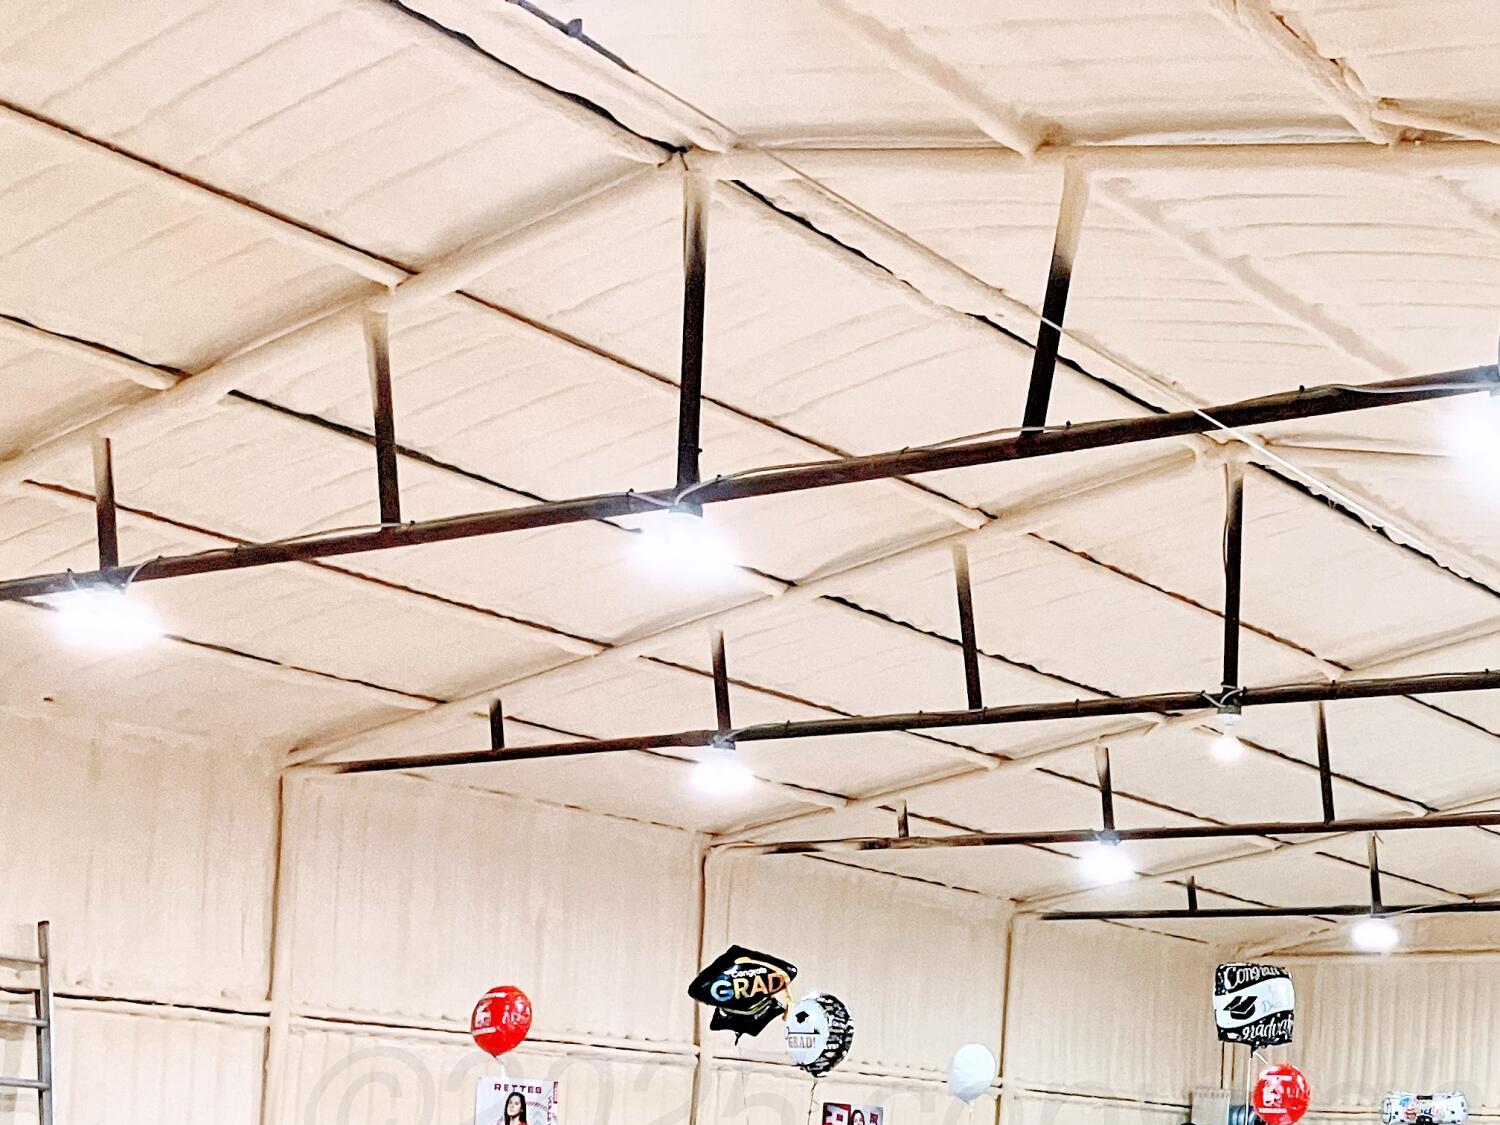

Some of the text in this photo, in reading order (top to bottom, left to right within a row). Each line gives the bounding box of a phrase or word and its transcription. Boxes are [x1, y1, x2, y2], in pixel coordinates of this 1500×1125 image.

[710, 973, 785, 1002] GRAD
[1224, 966, 1280, 990] Congrats
[1242, 1013, 1294, 1040] graduat
[788, 1036, 815, 1049] GRAD!
